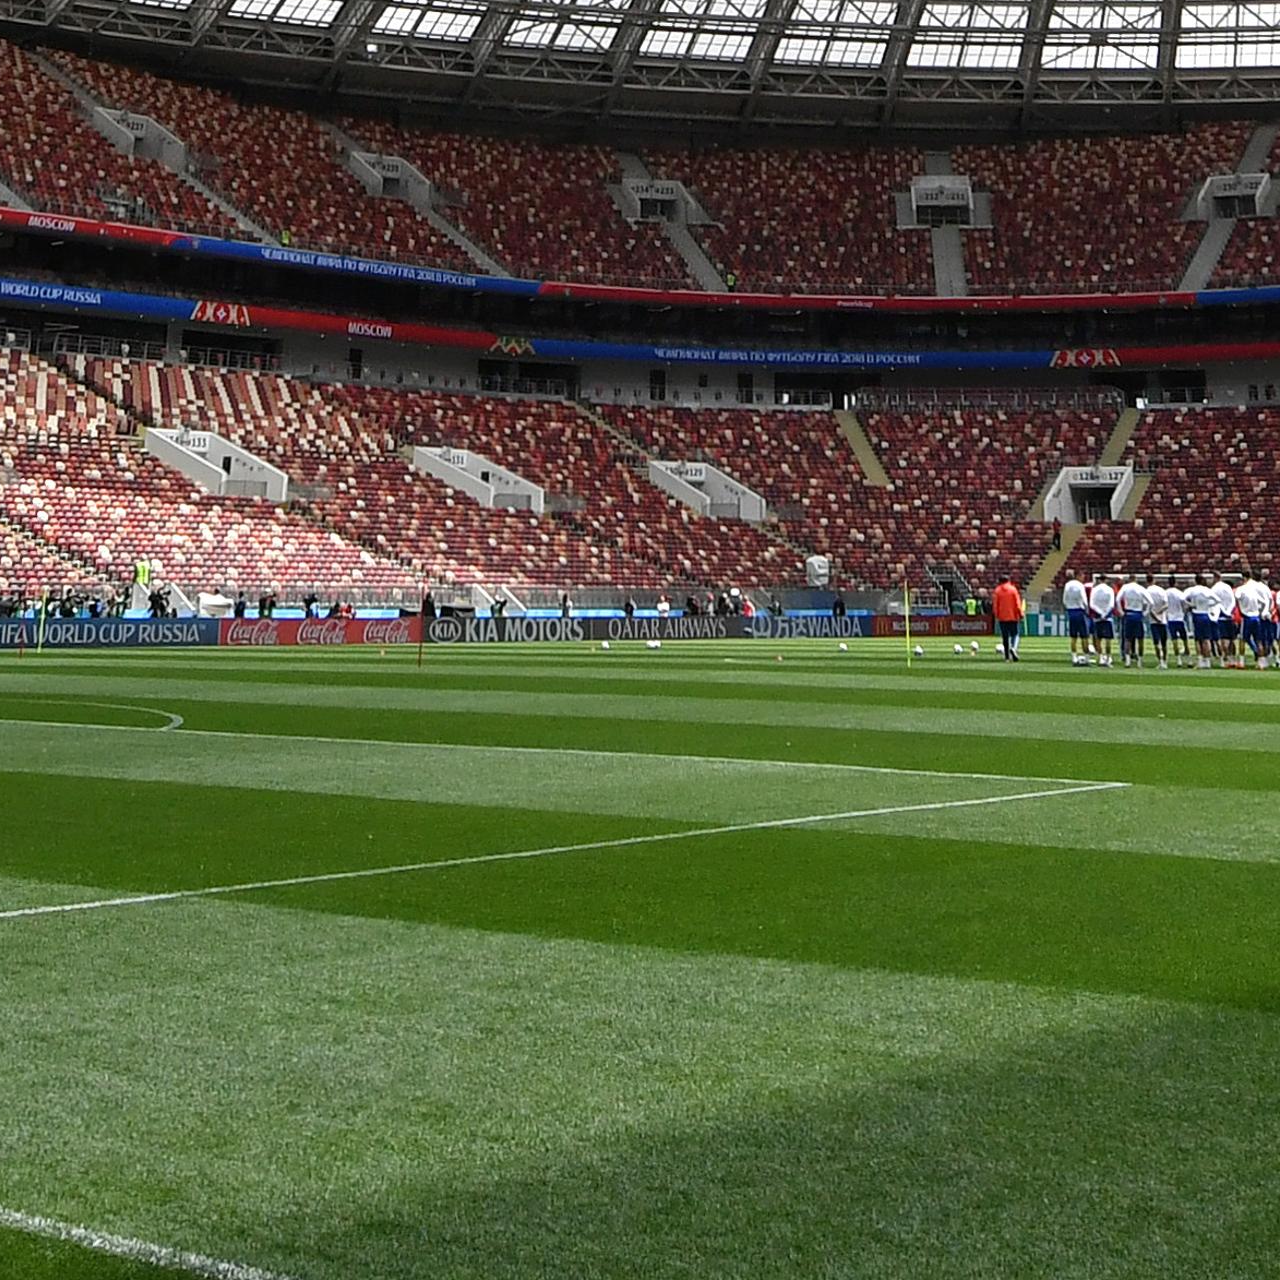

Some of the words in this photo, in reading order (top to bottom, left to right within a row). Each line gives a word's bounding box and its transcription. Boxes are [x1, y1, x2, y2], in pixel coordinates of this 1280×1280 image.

[28, 215, 76, 232] MOSCOW
[1, 281, 39, 297] WORLD
[39, 285, 63, 299] CUP
[63, 288, 102, 304] RUSSIA
[348, 321, 393, 338] MOSCOW
[33, 624, 96, 644] WORLD
[99, 624, 136, 644] CUP
[138, 624, 200, 644] RUSSIA
[432, 623, 459, 639] KIA
[465, 619, 499, 641] KIA
[504, 618, 584, 641] MOTORS
[608, 618, 660, 640] QATAR
[663, 617, 726, 638] AIRWAYS
[806, 617, 861, 636] WANDA
